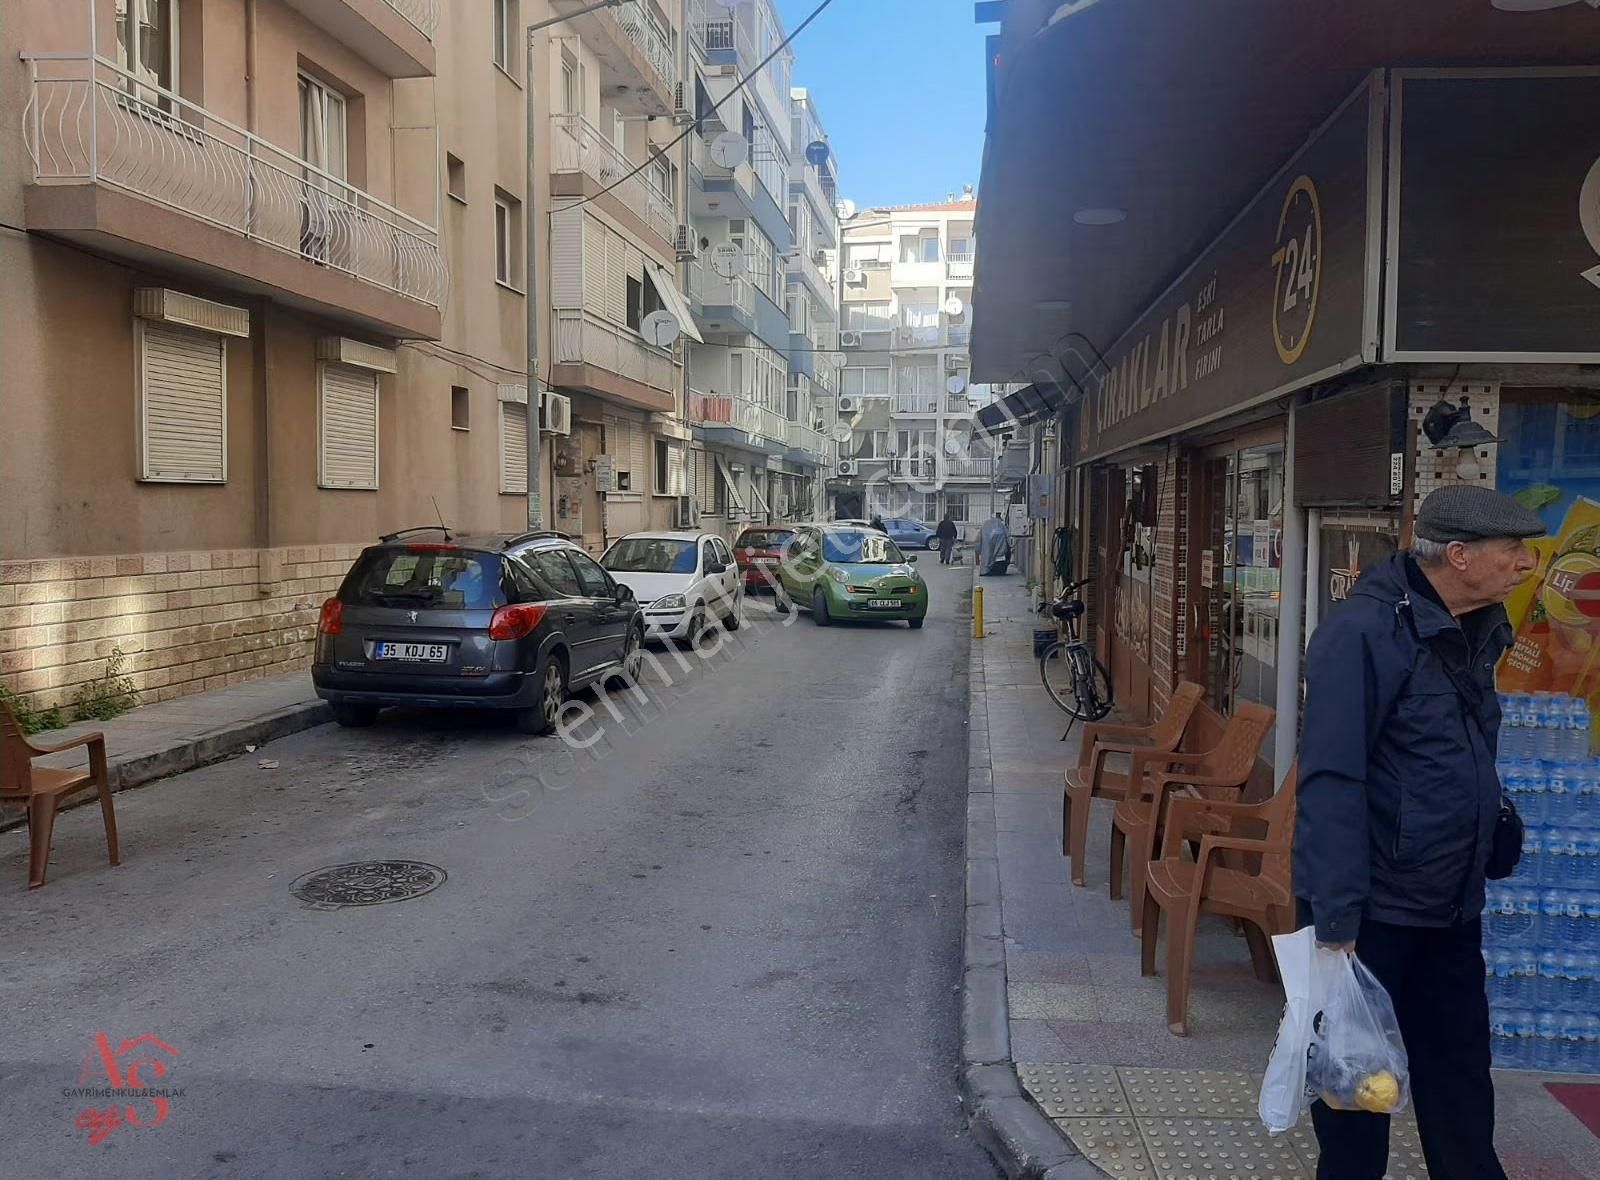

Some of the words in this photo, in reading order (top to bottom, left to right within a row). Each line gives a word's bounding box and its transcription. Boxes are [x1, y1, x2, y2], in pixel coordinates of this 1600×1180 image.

[1196, 307, 1224, 347] TARLA
[1097, 303, 1191, 447] ÇIRAKLAR
[1195, 345, 1222, 381] FIRINI
[383, 644, 396, 657] 35
[429, 646, 443, 658] 65
